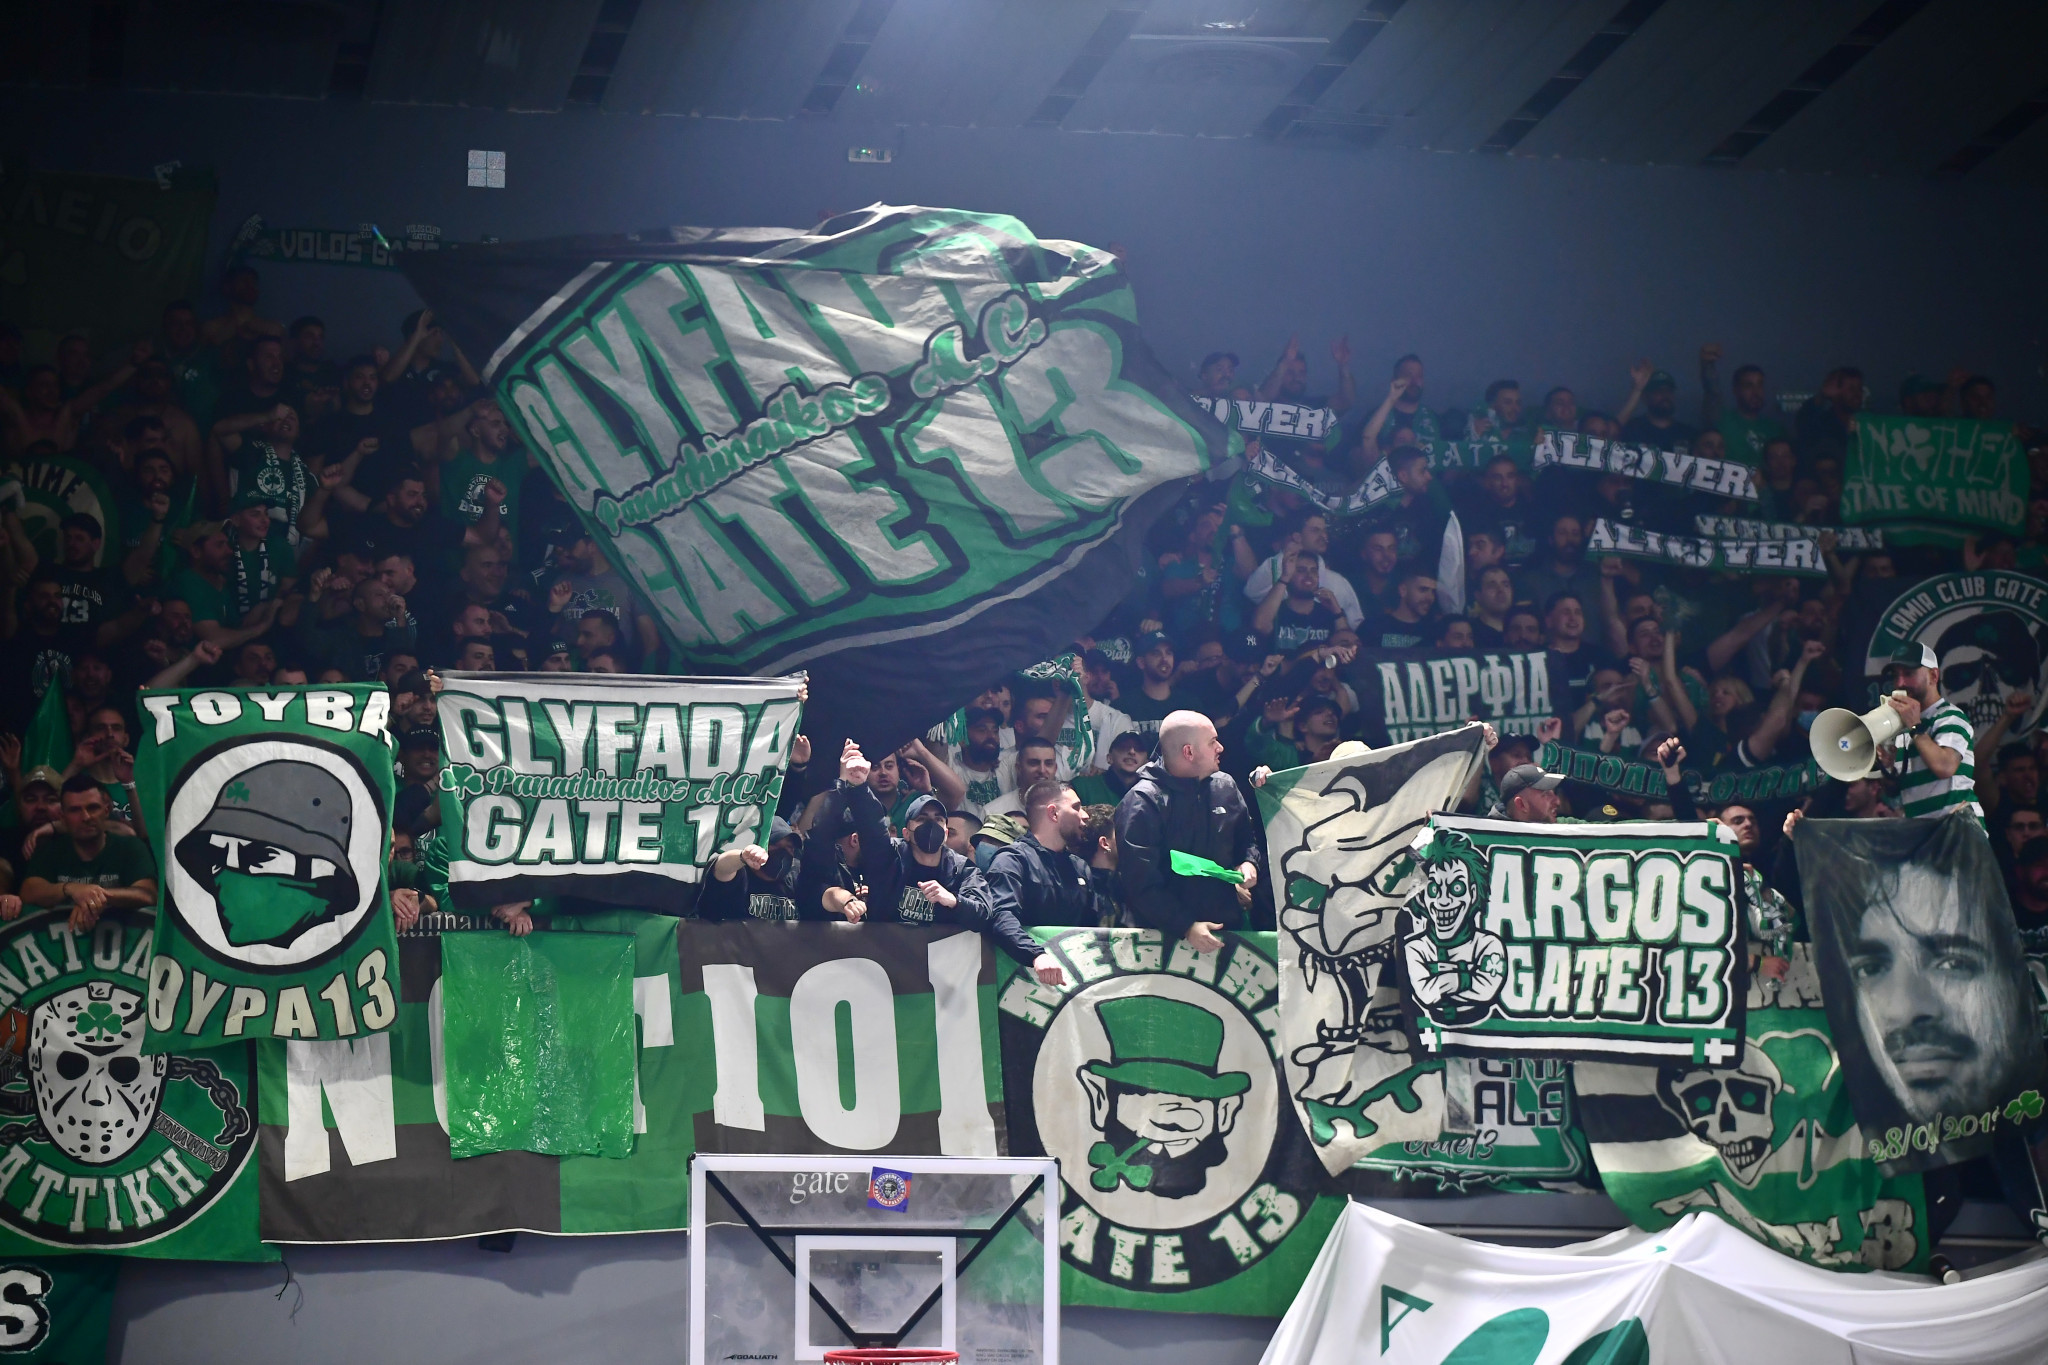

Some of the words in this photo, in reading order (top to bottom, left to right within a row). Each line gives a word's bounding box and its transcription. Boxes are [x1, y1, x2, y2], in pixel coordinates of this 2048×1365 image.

[280, 230, 361, 263] VOLOS
[594, 370, 892, 537] Panathinaikos
[616, 424, 945, 646] GATE
[907, 320, 1204, 540] 13
[1915, 484, 1949, 512] OF
[1955, 487, 2026, 526] MIND
[1885, 592, 1936, 640] LAMIA
[1935, 576, 1986, 602] CLUB
[1994, 578, 2047, 610] GATE
[438, 693, 798, 779] GLYFADA
[485, 765, 690, 802] Panathinaikos
[464, 796, 662, 865] GATE
[687, 801, 762, 867] 13
[1485, 851, 1729, 947] ARGOS
[1501, 944, 1641, 1018] GATE
[1662, 947, 1726, 1020] 13
[791, 1171, 849, 1204] gate
[1209, 1183, 1299, 1265] 13
